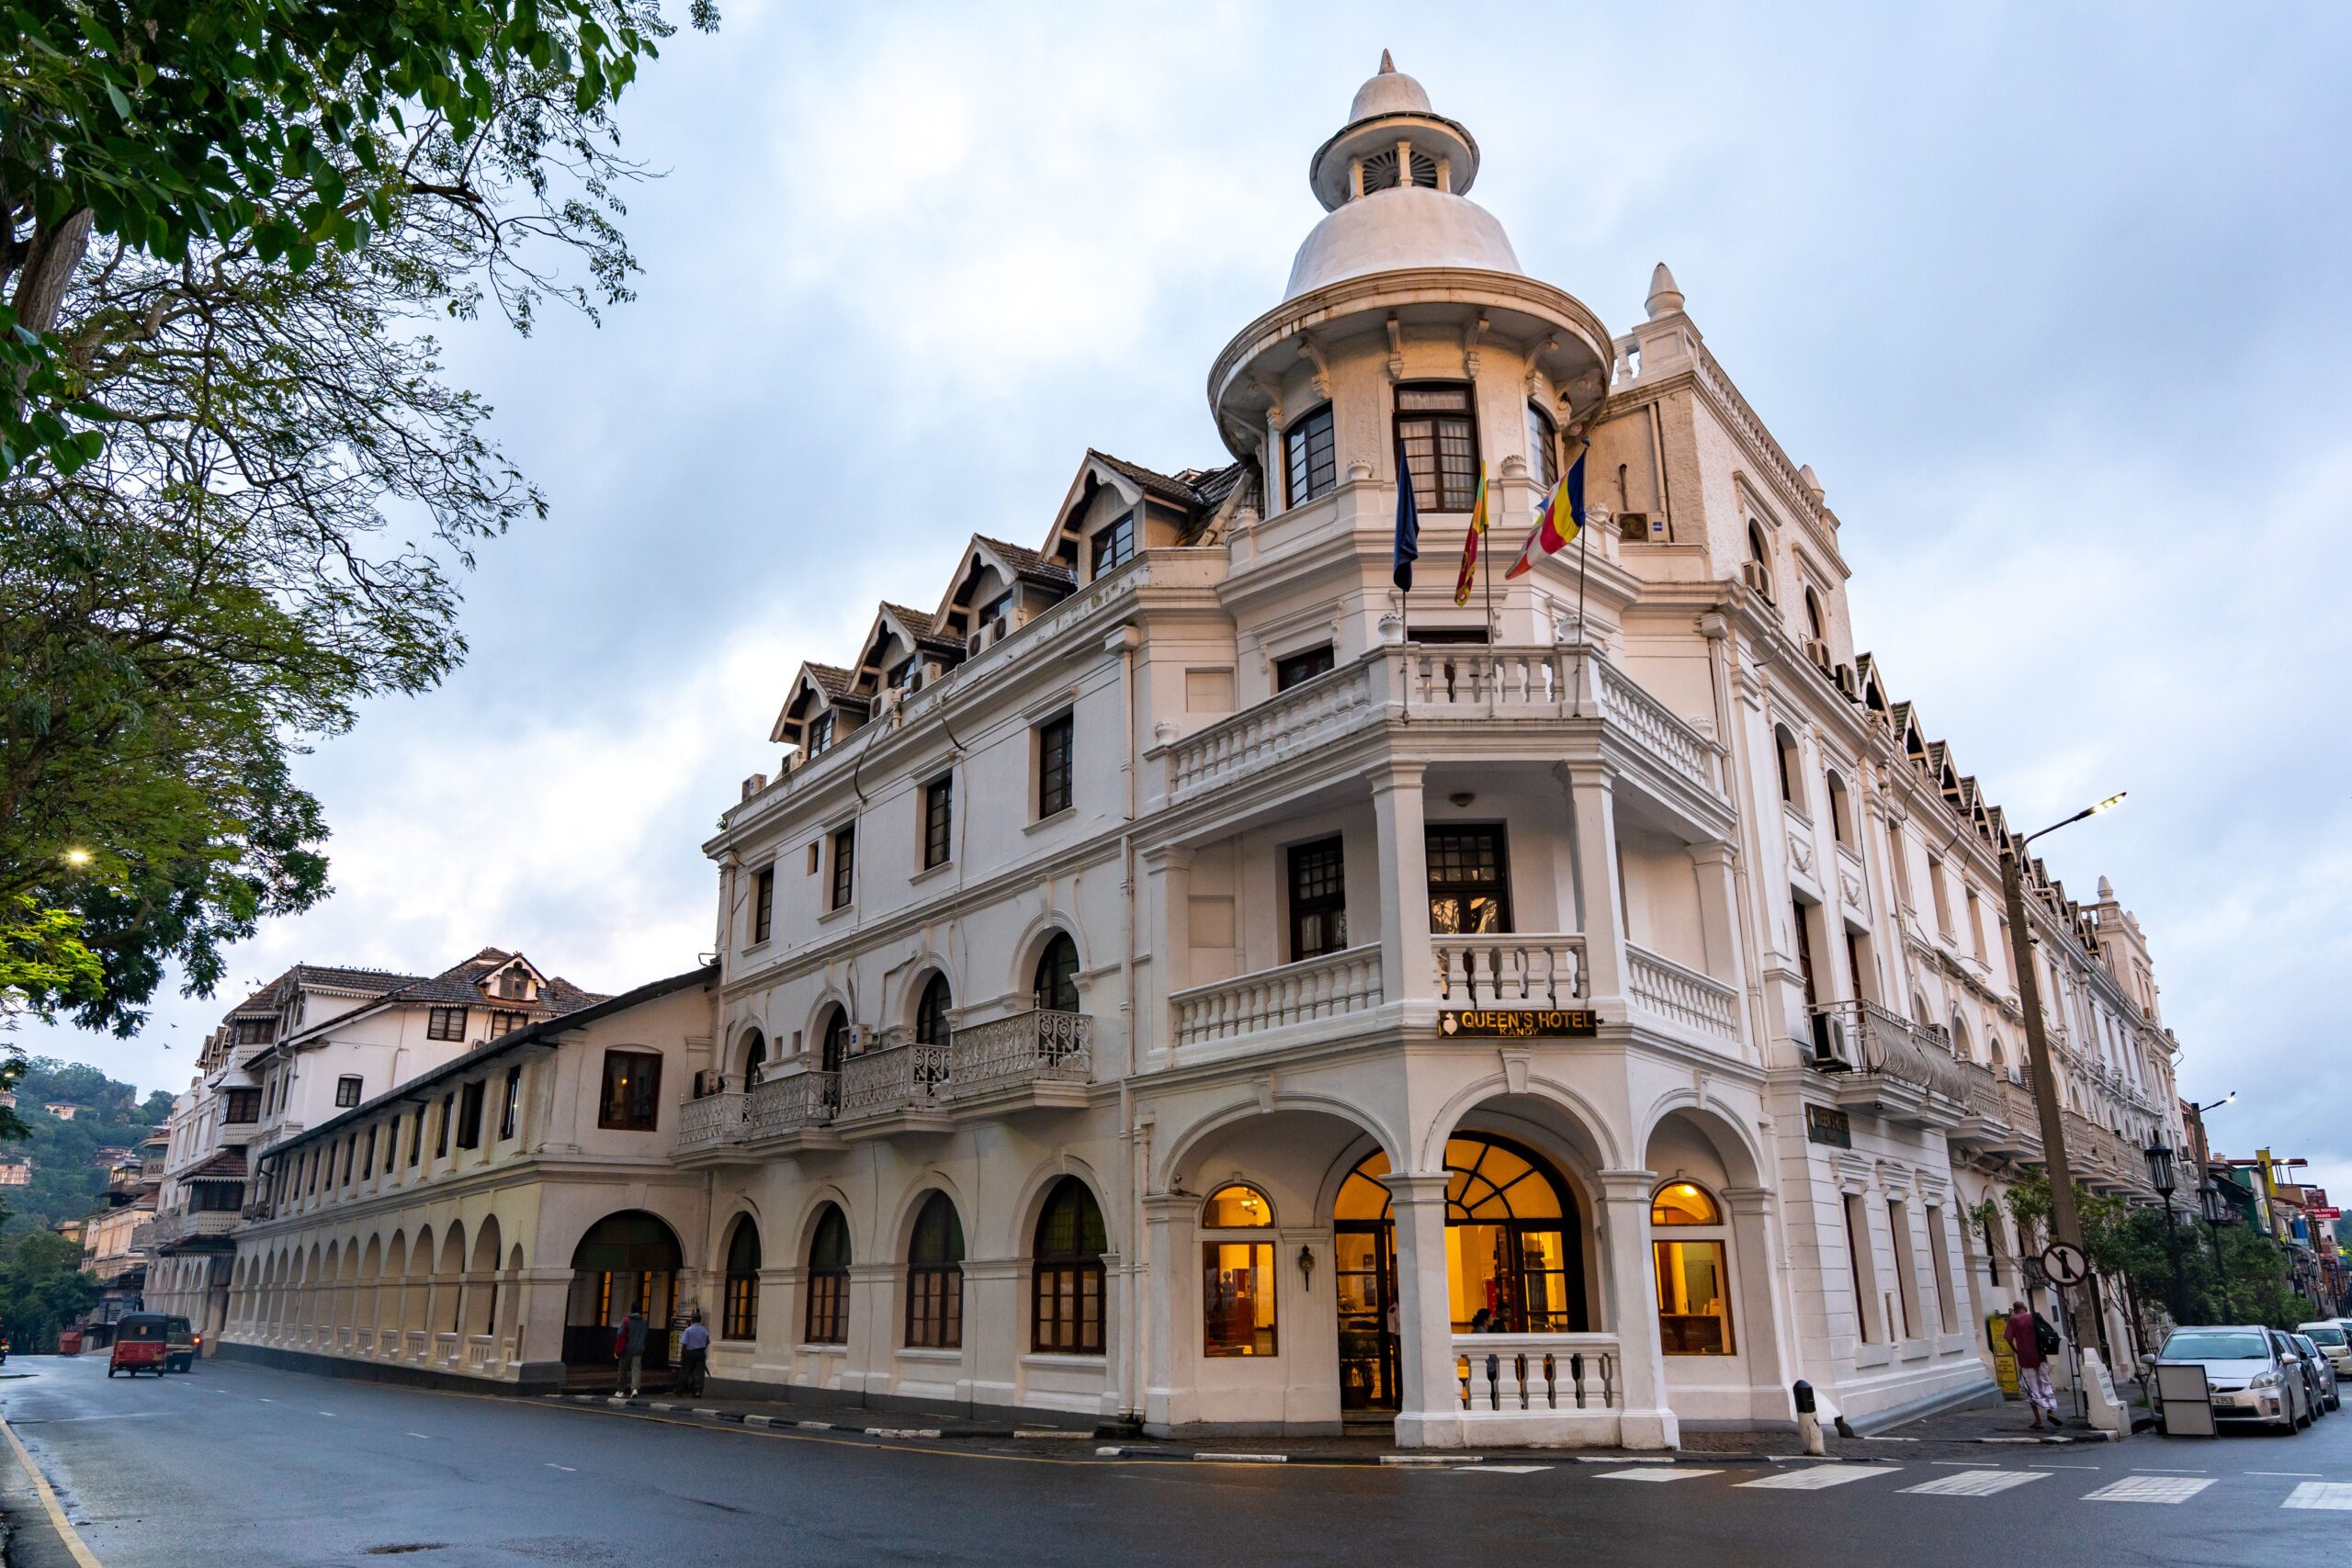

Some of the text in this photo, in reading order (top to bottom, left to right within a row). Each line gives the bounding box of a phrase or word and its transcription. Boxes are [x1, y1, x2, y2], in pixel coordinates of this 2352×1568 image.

[1462, 1011, 1594, 1028] QUEEN'S HOTEL
[1499, 1027, 1539, 1036] KANDY
